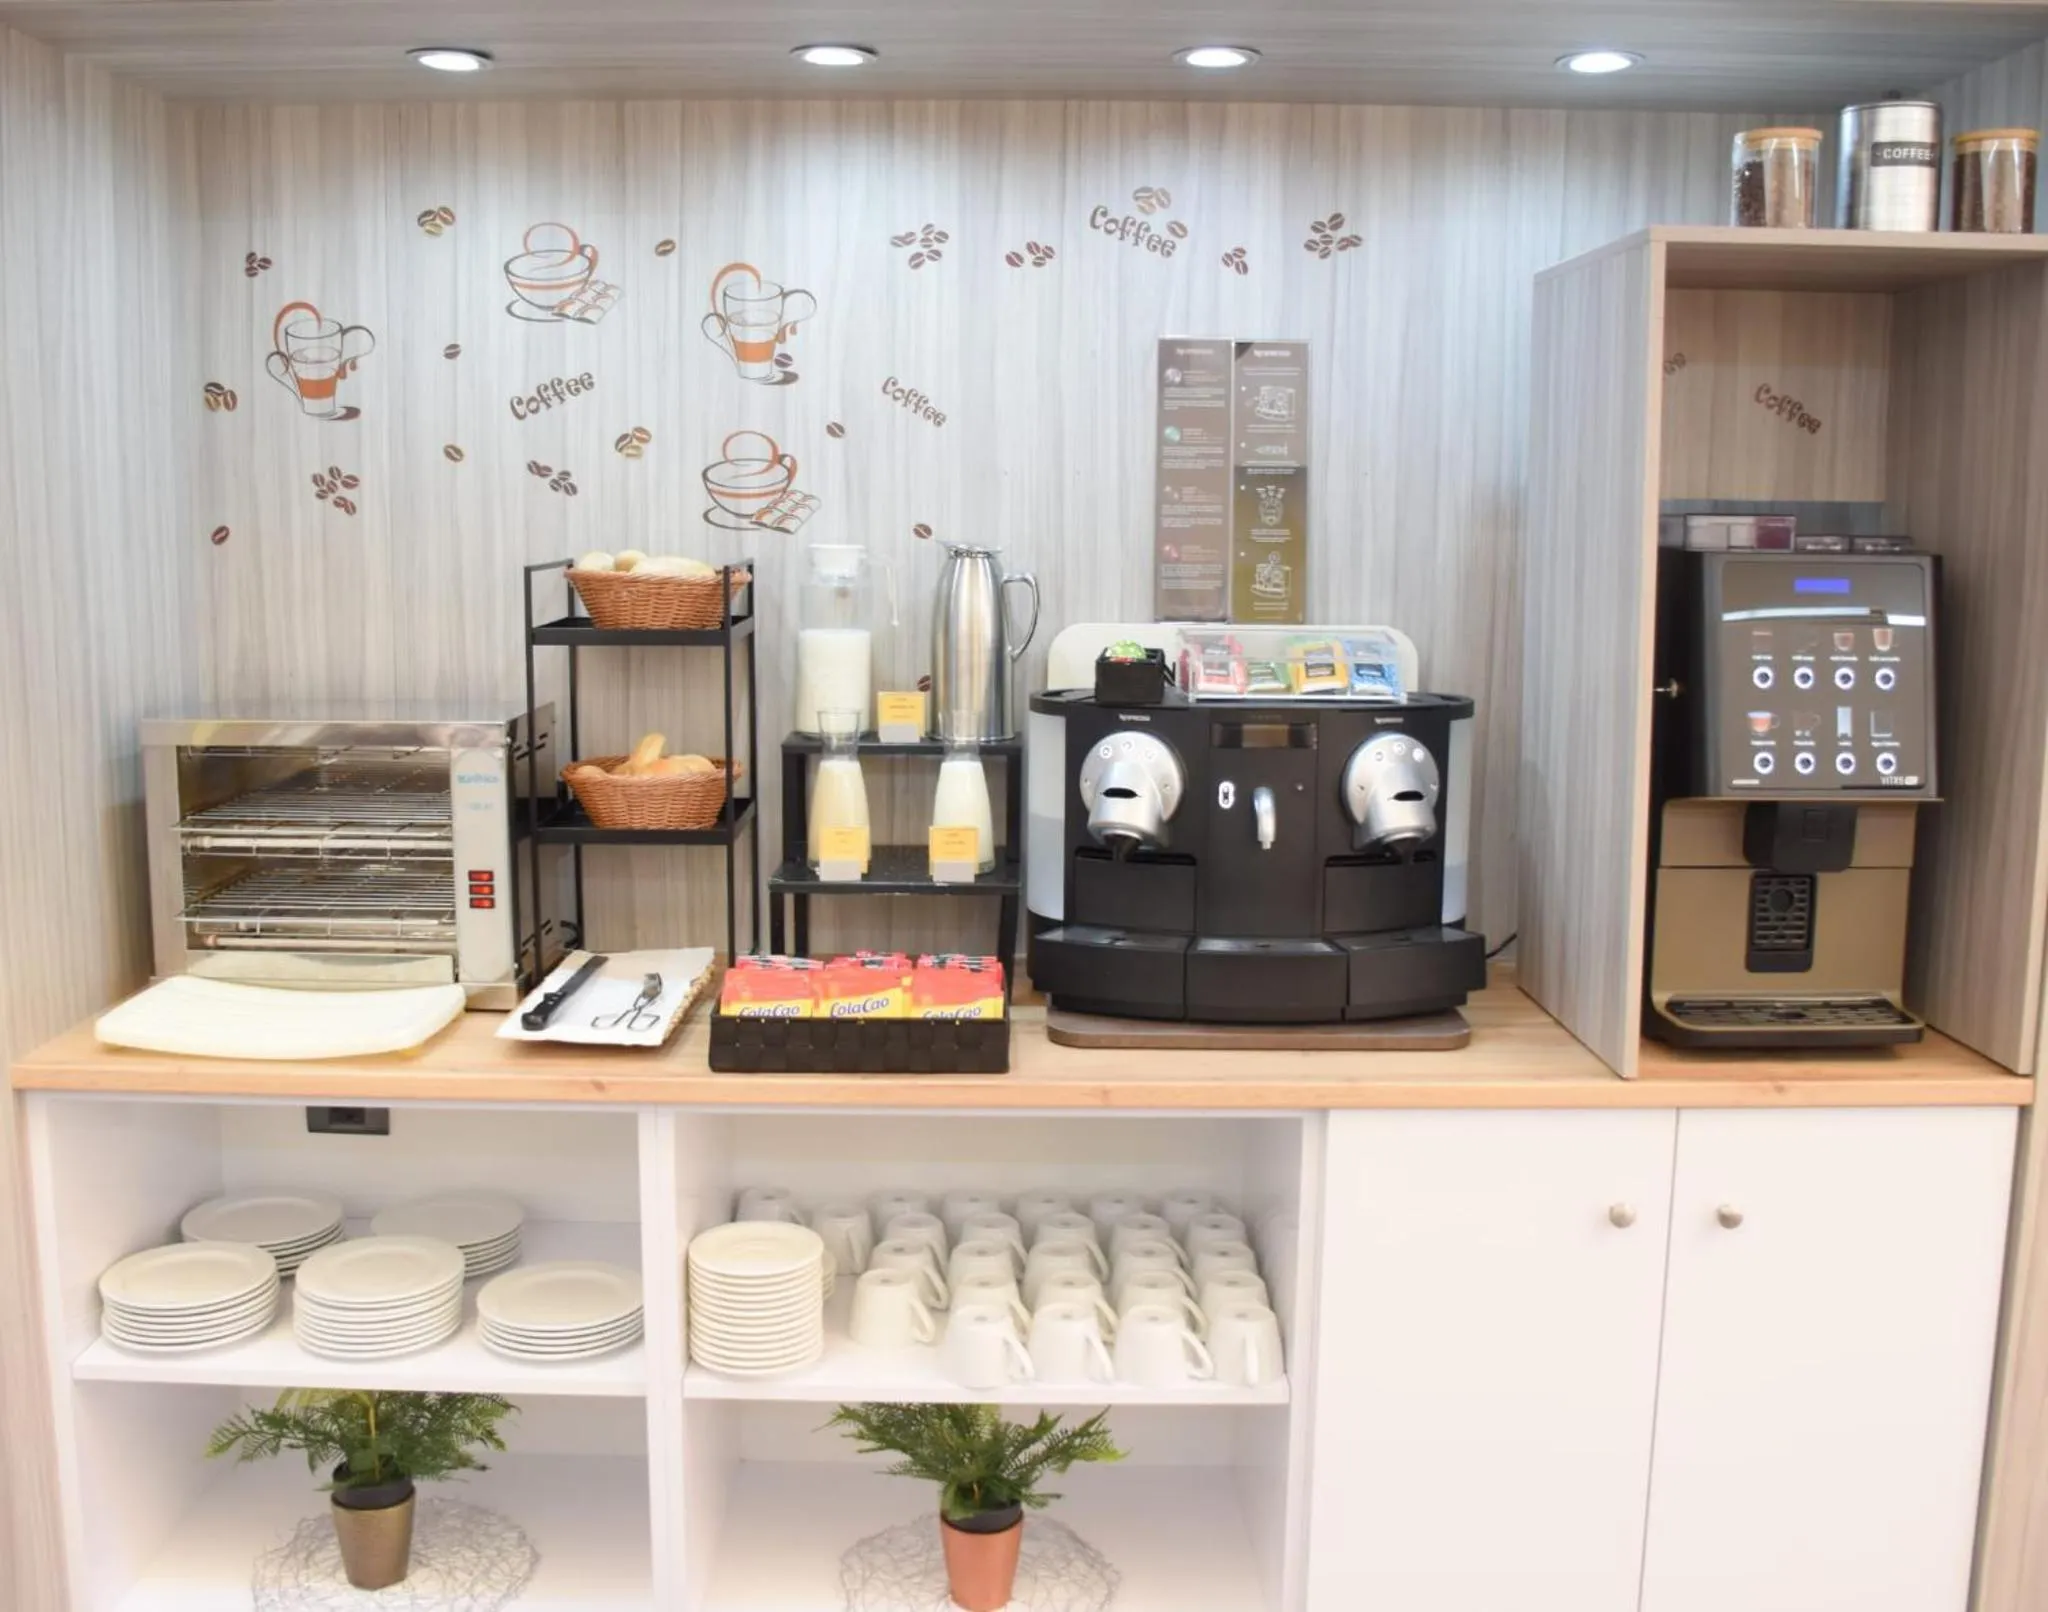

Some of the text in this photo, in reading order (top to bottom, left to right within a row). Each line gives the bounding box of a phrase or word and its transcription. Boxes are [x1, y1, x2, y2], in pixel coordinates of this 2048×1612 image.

[1089, 204, 1177, 258] Coffee
[509, 371, 594, 421] Coffee
[881, 376, 947, 427] Coffee
[1755, 383, 1822, 435] Coffee
[830, 996, 889, 1018] ColaCao
